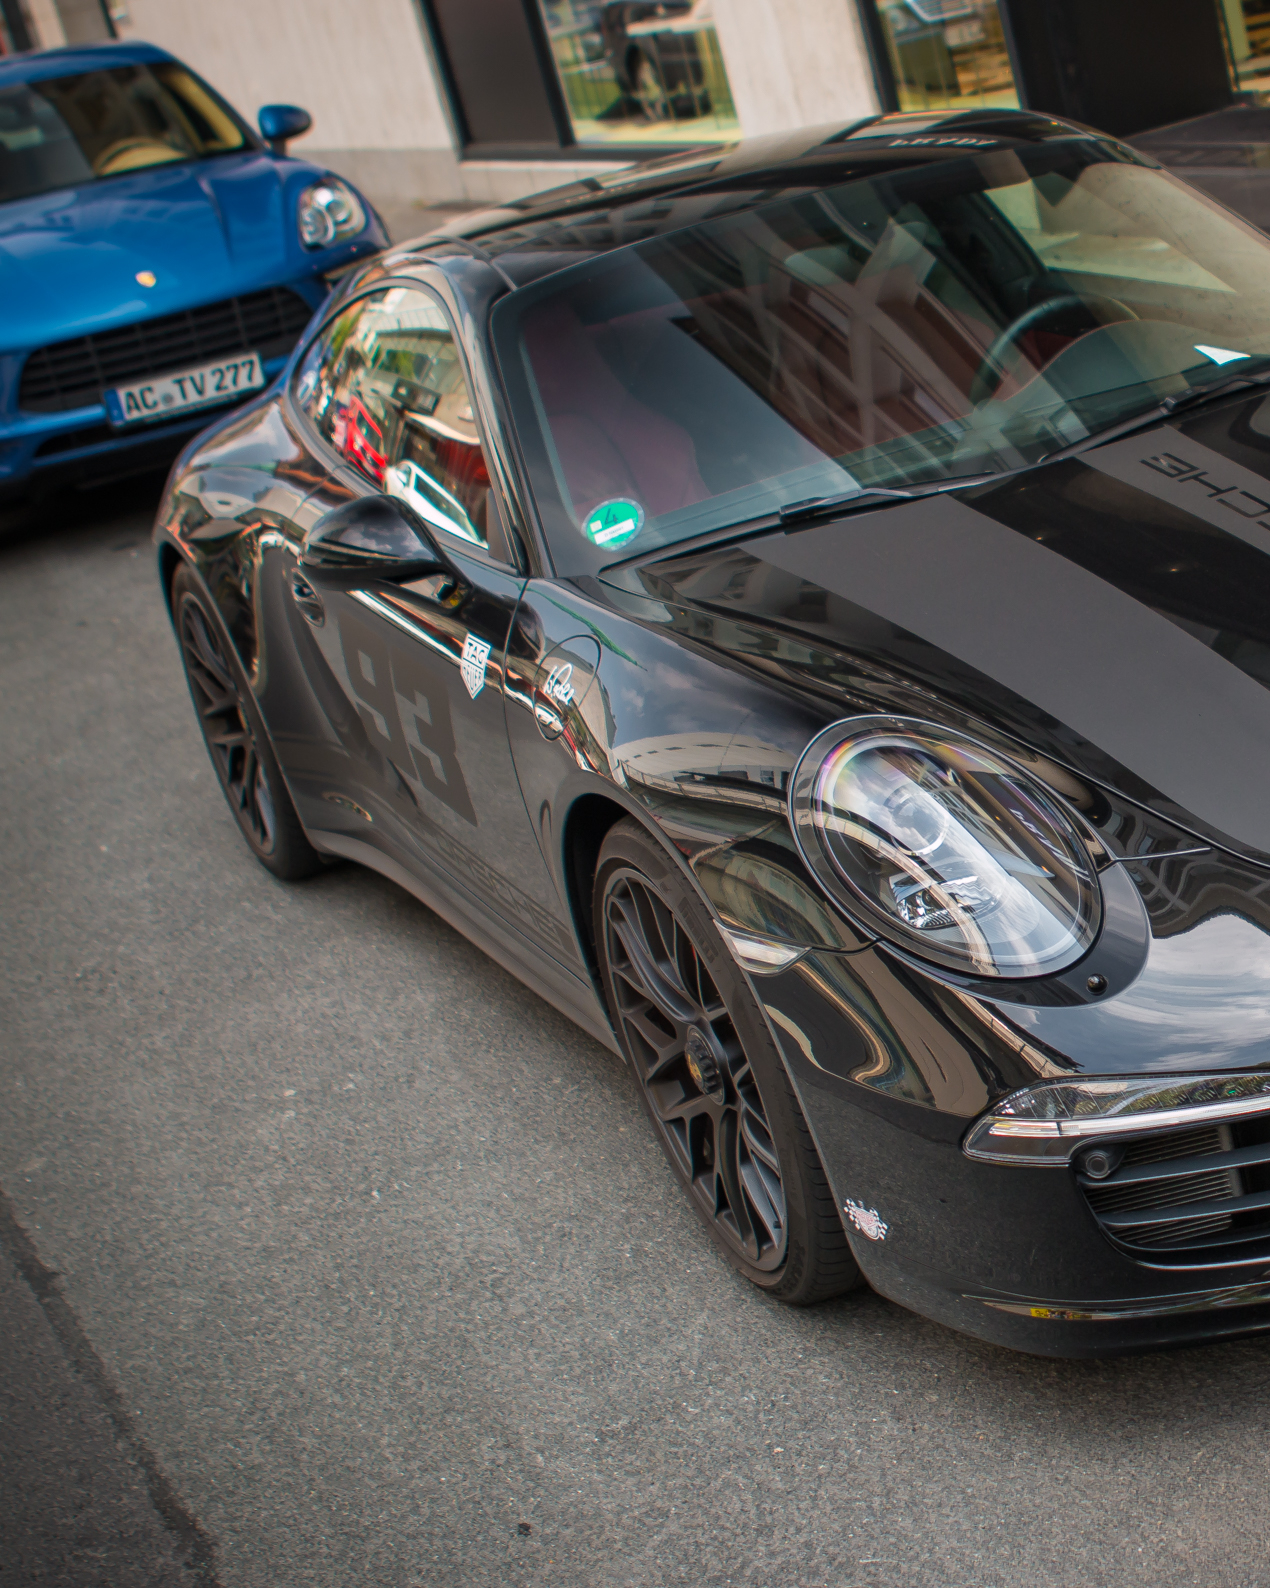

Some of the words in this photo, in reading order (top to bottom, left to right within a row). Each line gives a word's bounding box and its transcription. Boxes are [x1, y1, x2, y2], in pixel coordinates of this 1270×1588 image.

[124, 386, 158, 415] AC
[172, 372, 206, 401] TV
[211, 359, 255, 392] 277
[466, 641, 485, 665] TAG
[338, 613, 478, 828] 93
